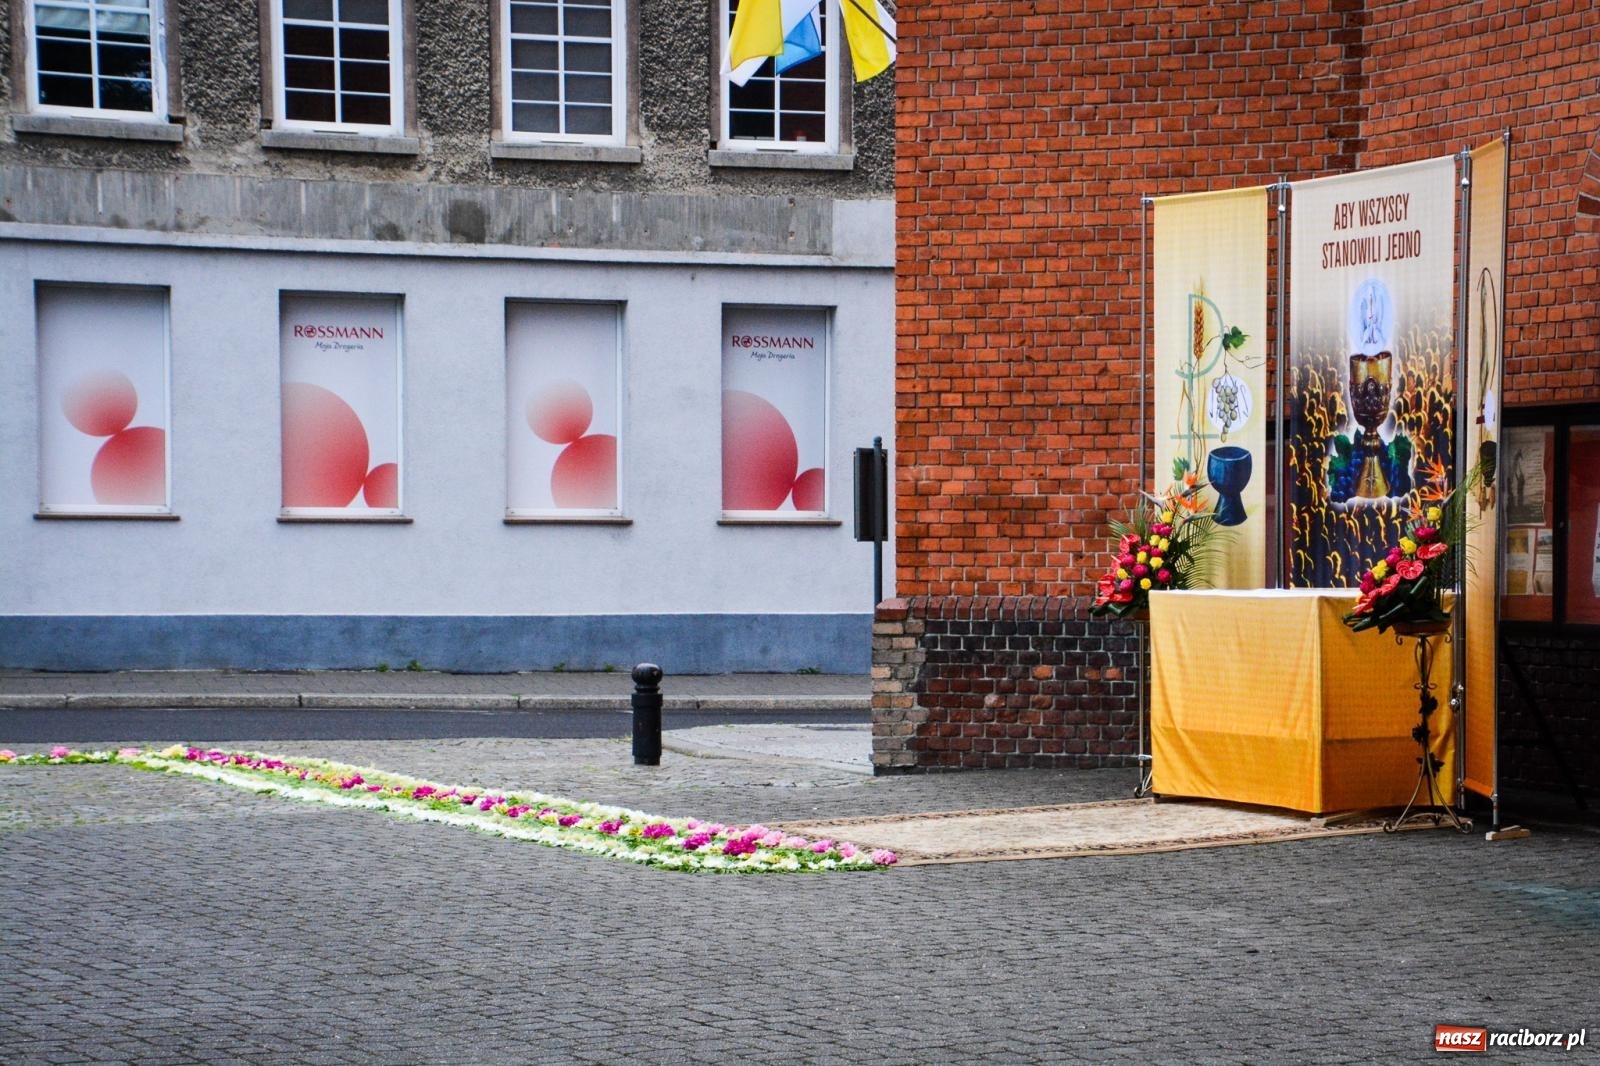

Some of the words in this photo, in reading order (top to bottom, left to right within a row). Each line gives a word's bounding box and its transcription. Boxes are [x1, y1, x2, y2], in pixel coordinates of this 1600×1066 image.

[1334, 202, 1355, 231] ABY
[1359, 193, 1410, 227] WSZYSCY
[1322, 235, 1381, 270] STANOWILI
[1385, 229, 1421, 261] JEDNO
[294, 324, 384, 339] ROSSMANN
[732, 335, 814, 349] ROSSMANN
